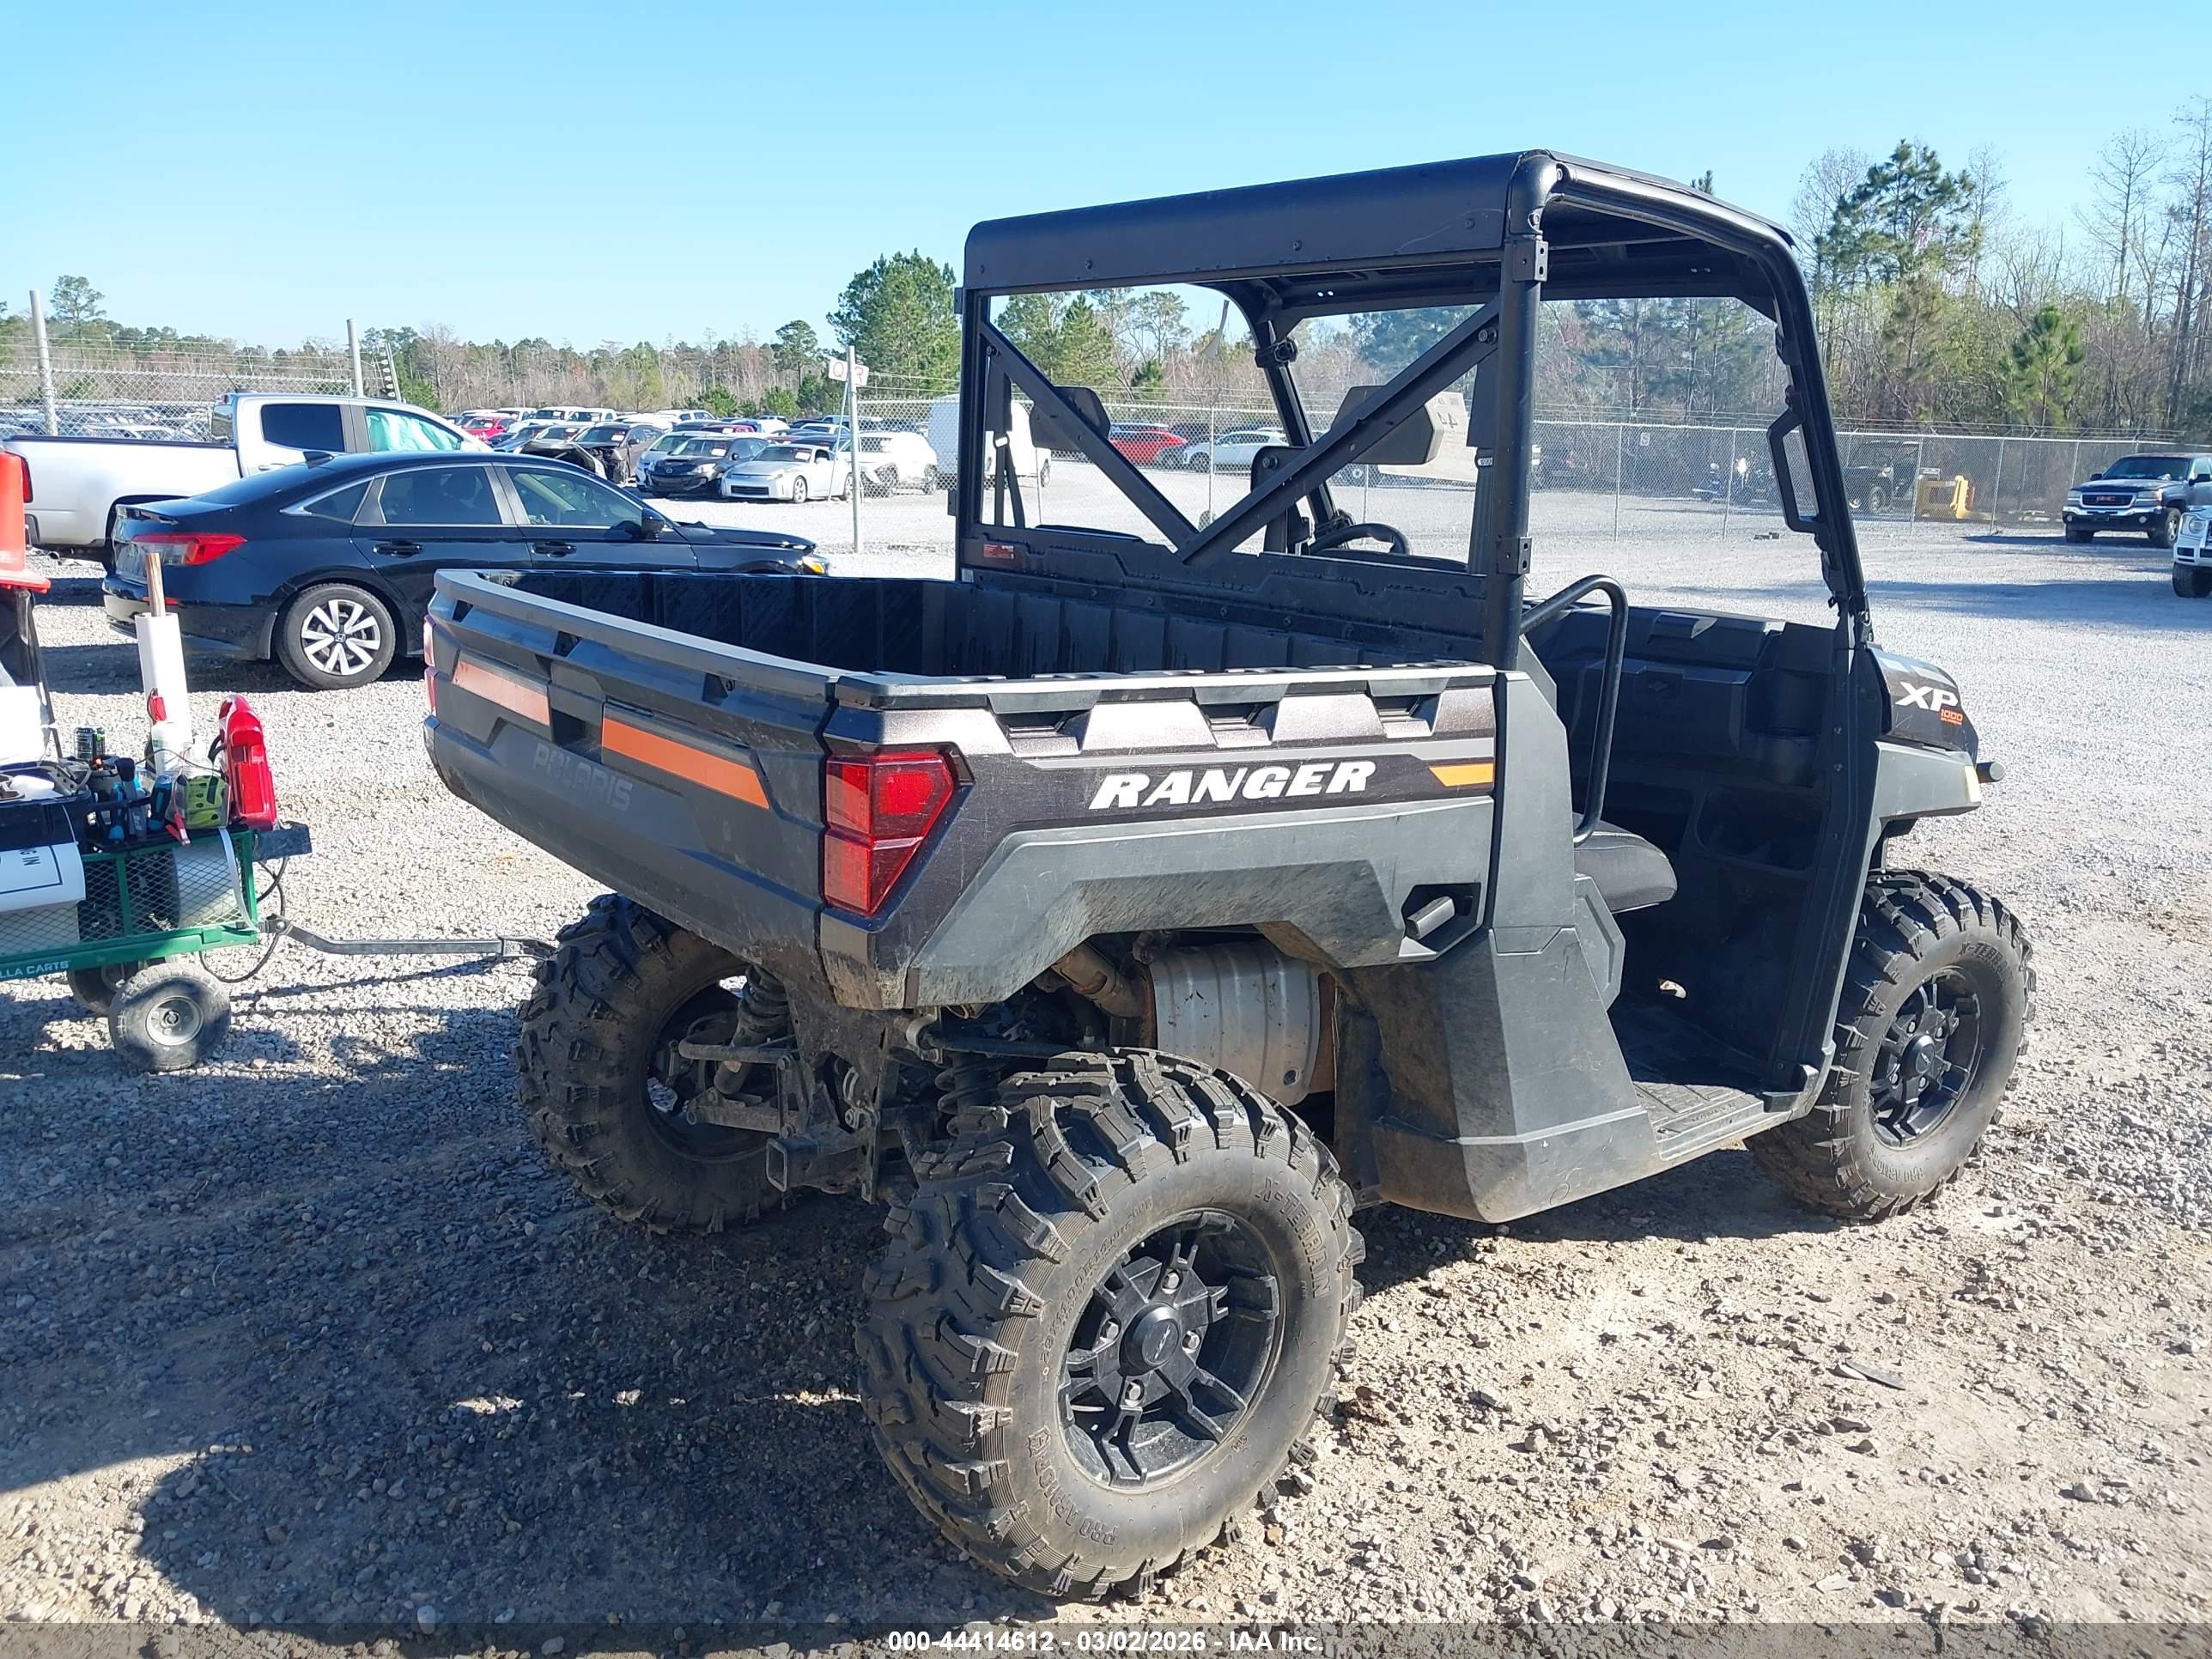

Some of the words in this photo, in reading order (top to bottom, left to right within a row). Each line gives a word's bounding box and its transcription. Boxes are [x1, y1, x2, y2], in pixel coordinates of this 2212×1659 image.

[833, 361, 844, 379] Q
[1894, 681, 1959, 712] XP
[1941, 708, 1963, 722] 1000
[533, 742, 633, 811] POLARIS
[1088, 760, 1376, 810] RANGER
[27, 960, 69, 975] CARTS
[1255, 1176, 1330, 1298] X-TERRAIN
[1079, 1516, 1117, 1546] PRO
